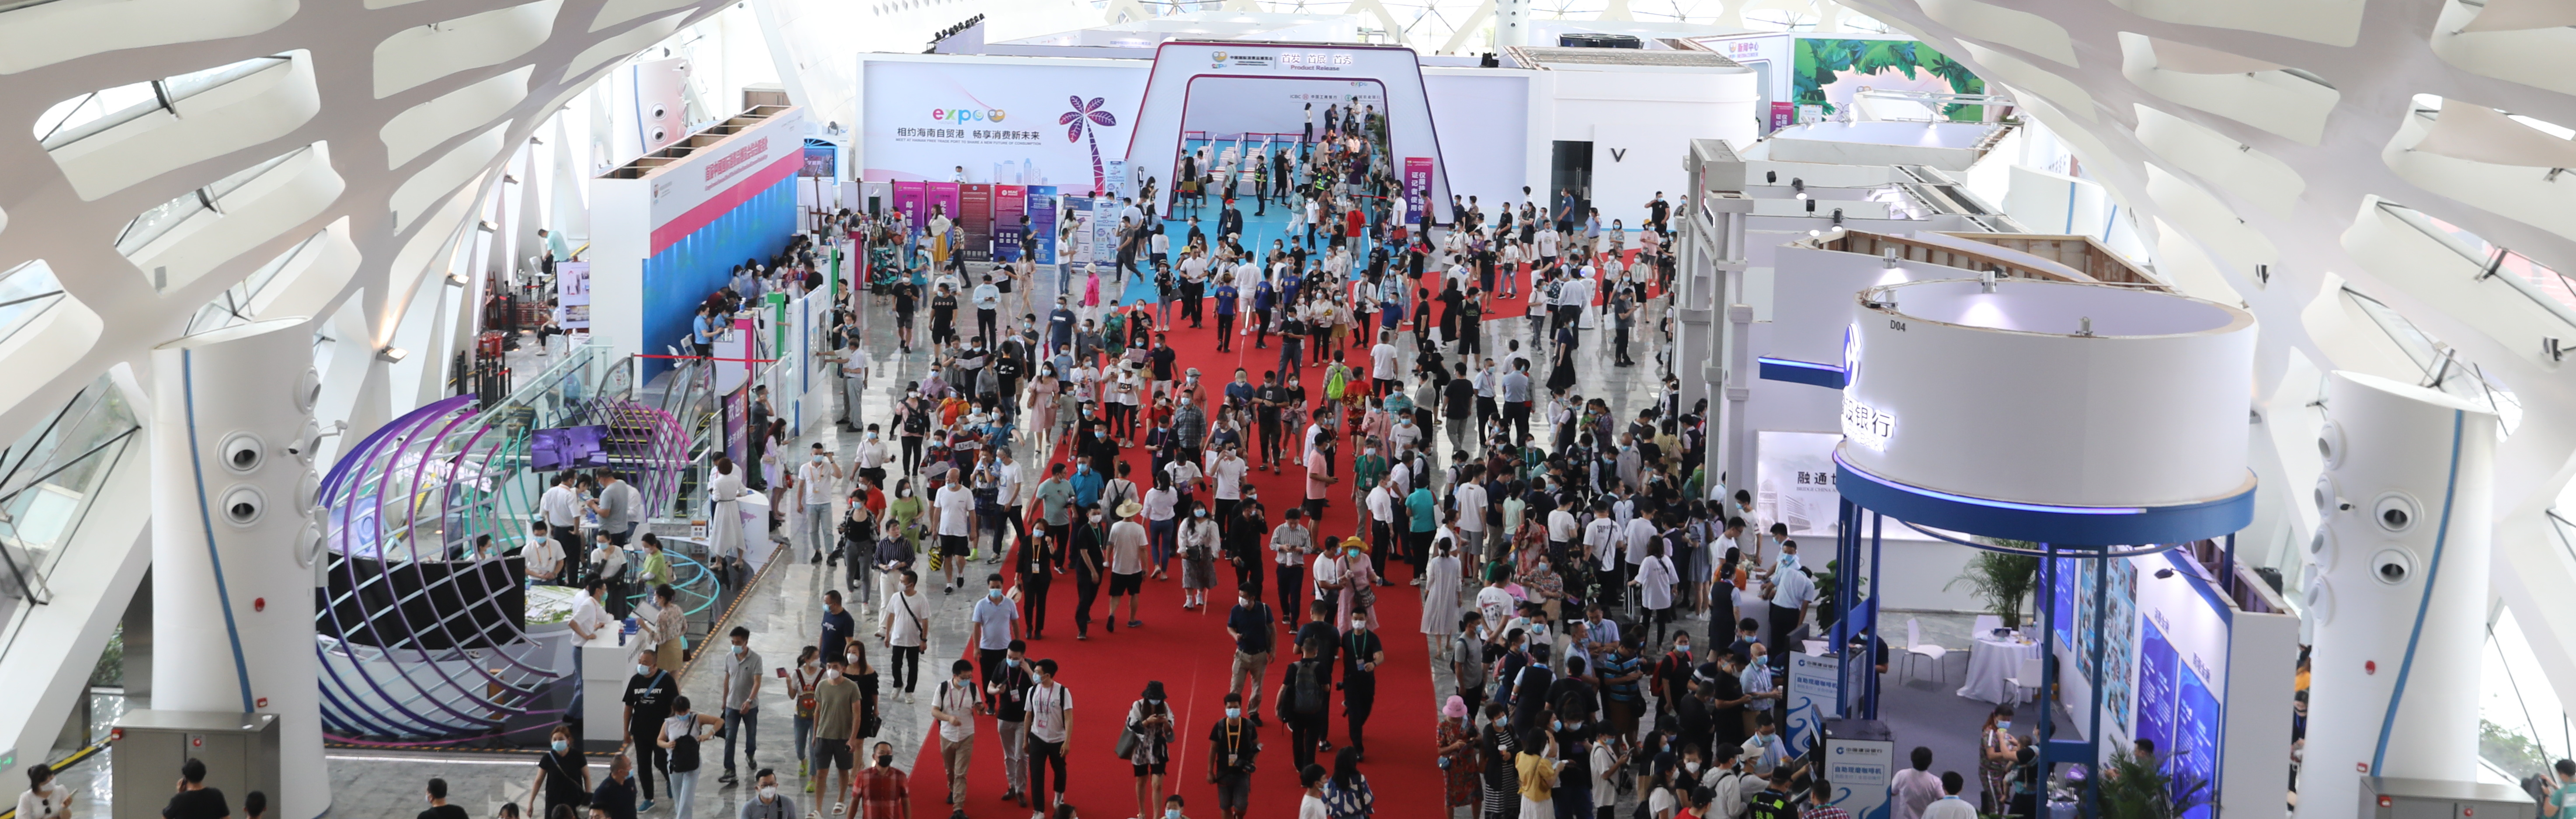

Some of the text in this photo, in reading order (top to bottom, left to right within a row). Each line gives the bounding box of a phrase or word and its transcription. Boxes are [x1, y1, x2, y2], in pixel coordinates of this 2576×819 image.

[1737, 42, 1759, 52] 新闻中心
[1282, 54, 1352, 64] 首发 首展 首秀
[932, 108, 984, 125] expo
[897, 127, 1040, 140] 相约海南自贸港 畅享消费新未来
[1410, 172, 1419, 211] 证记者使用
[1890, 320, 1906, 332] D04
[1842, 397, 1891, 437] 设银行
